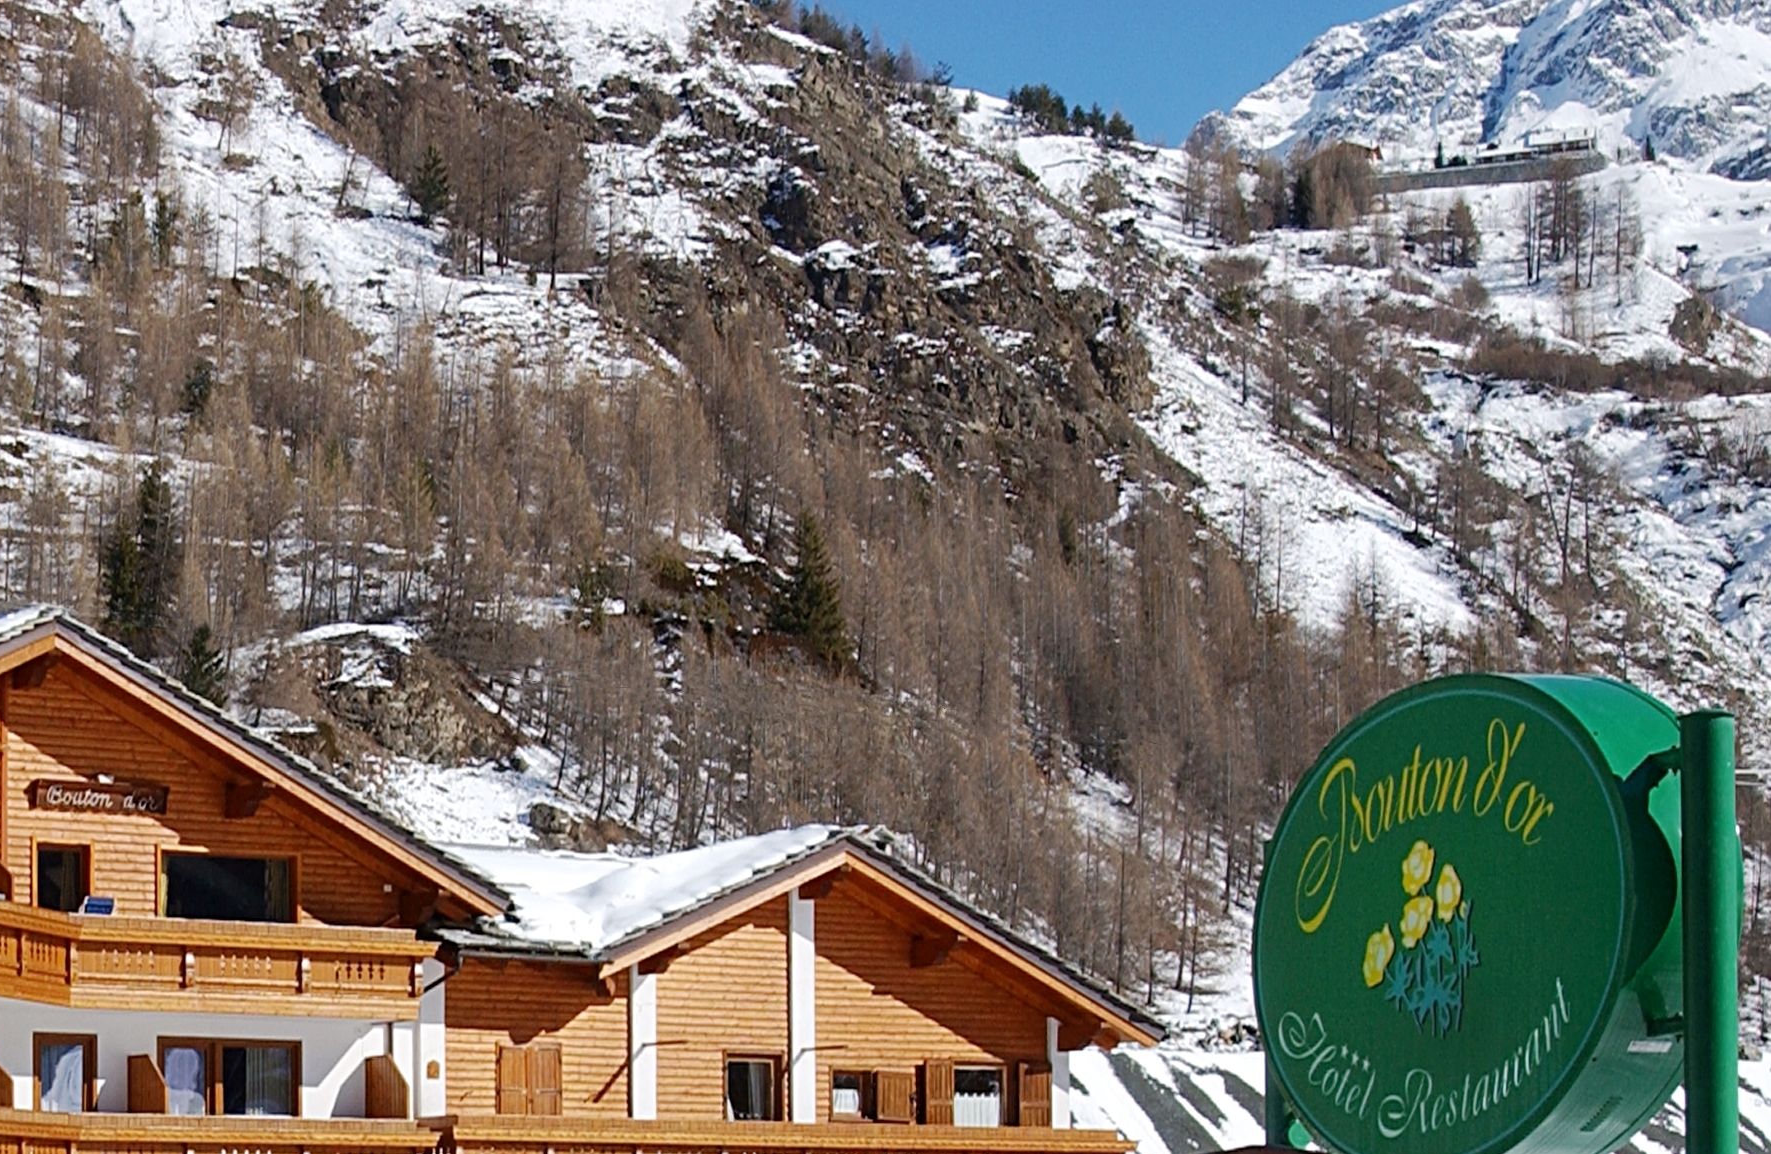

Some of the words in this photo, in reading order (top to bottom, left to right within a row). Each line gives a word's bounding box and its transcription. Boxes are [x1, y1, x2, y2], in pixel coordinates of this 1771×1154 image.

[46, 784, 113, 809] Bouton
[1295, 744, 1468, 933] Bouton
[1474, 718, 1554, 845] d'or
[1378, 977, 1571, 1138] Restaurant
